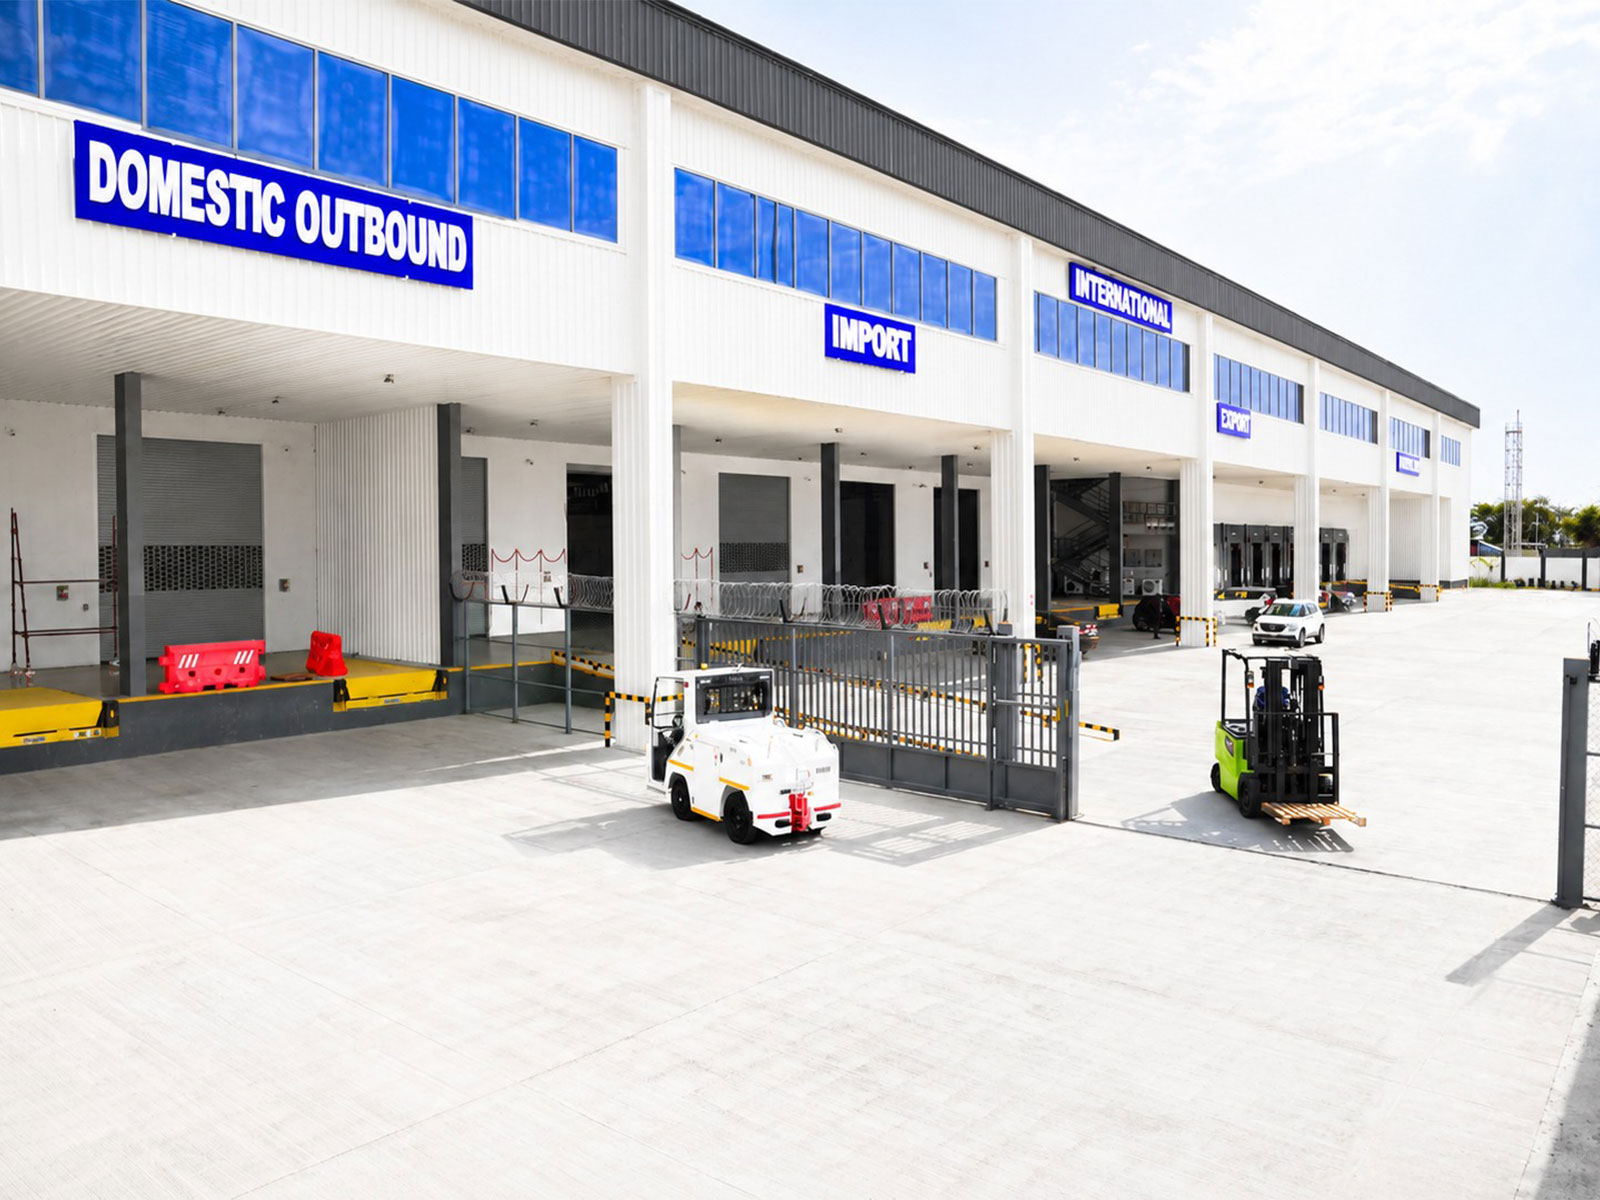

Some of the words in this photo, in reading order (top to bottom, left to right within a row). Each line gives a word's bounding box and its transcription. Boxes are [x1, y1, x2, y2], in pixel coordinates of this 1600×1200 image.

[89, 140, 286, 237] DOMESTIC
[295, 190, 467, 272] OUTBOUND
[1075, 268, 1171, 329] INTERNATIONAL
[832, 314, 912, 363] IMPORT
[1221, 407, 1250, 434] EXPORT
